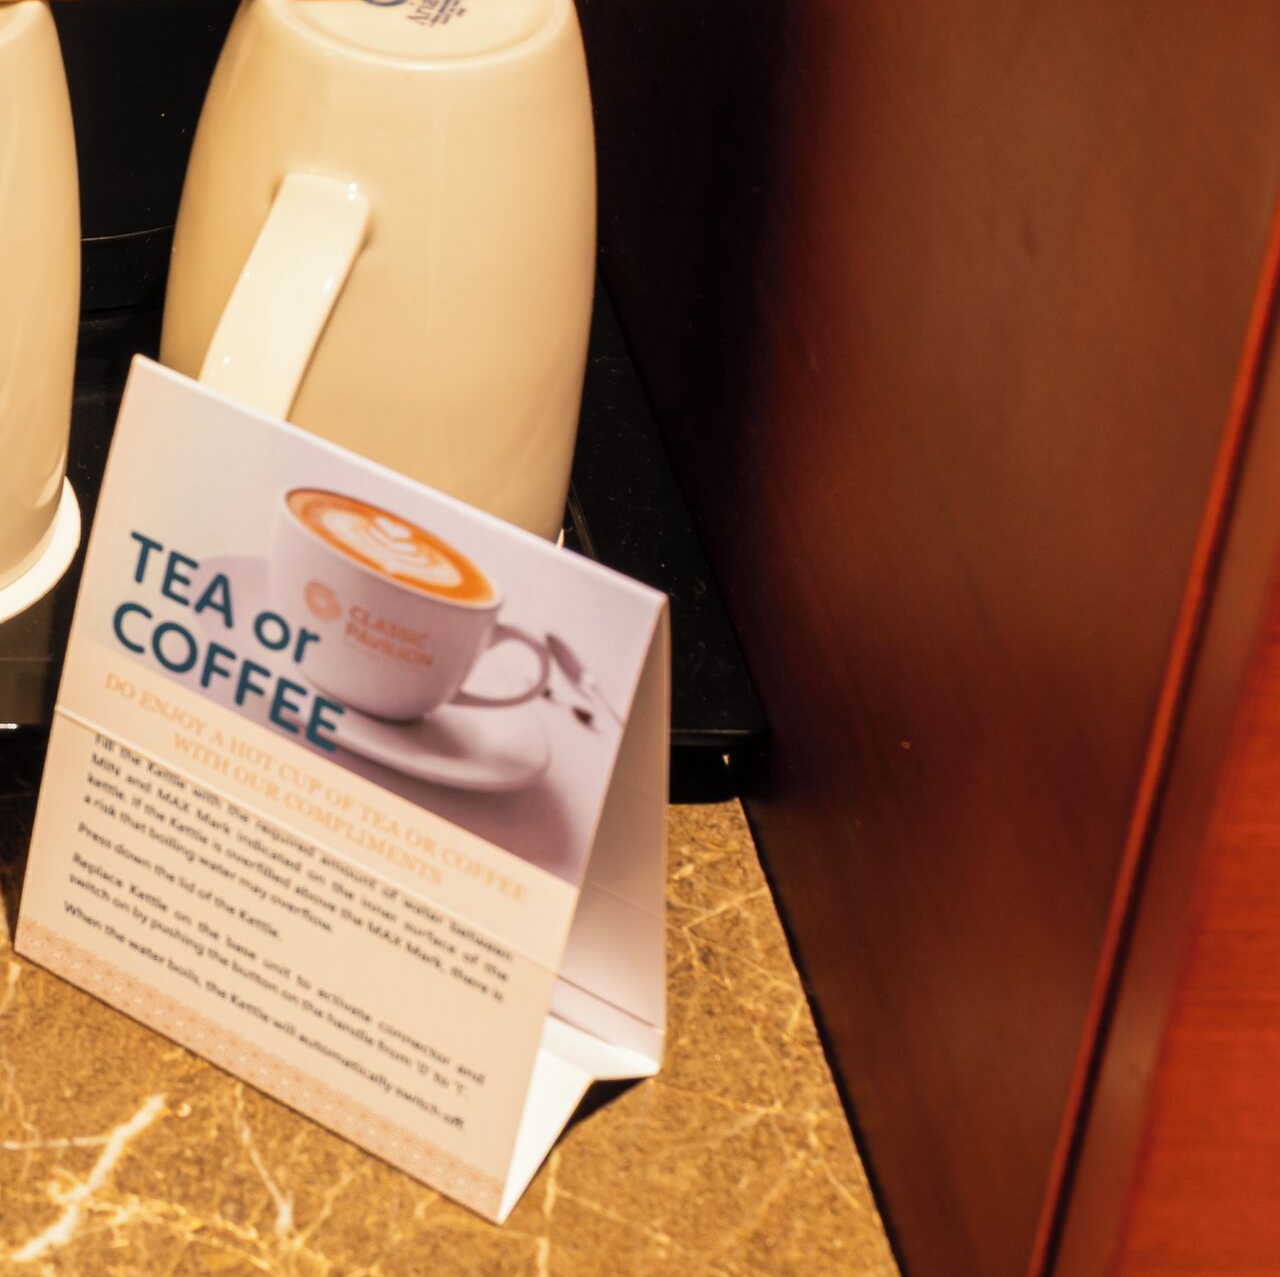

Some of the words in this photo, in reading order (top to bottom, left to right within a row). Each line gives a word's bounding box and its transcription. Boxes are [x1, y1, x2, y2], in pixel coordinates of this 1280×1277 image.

[131, 532, 234, 628] TEA
[254, 611, 321, 664] or
[114, 603, 346, 752] COFFEE
[104, 671, 136, 704] DO
[138, 689, 205, 739] ENJOY
[209, 725, 226, 750] A
[227, 735, 275, 775] HOT
[276, 760, 321, 798] CUP
[323, 784, 355, 816] OF
[356, 801, 402, 840] TEA
[403, 825, 437, 858] OR
[440, 844, 527, 903] COFFEE
[171, 731, 230, 777] WITH
[232, 762, 280, 802] OUR
[281, 788, 445, 888] COMPLIMENTS
